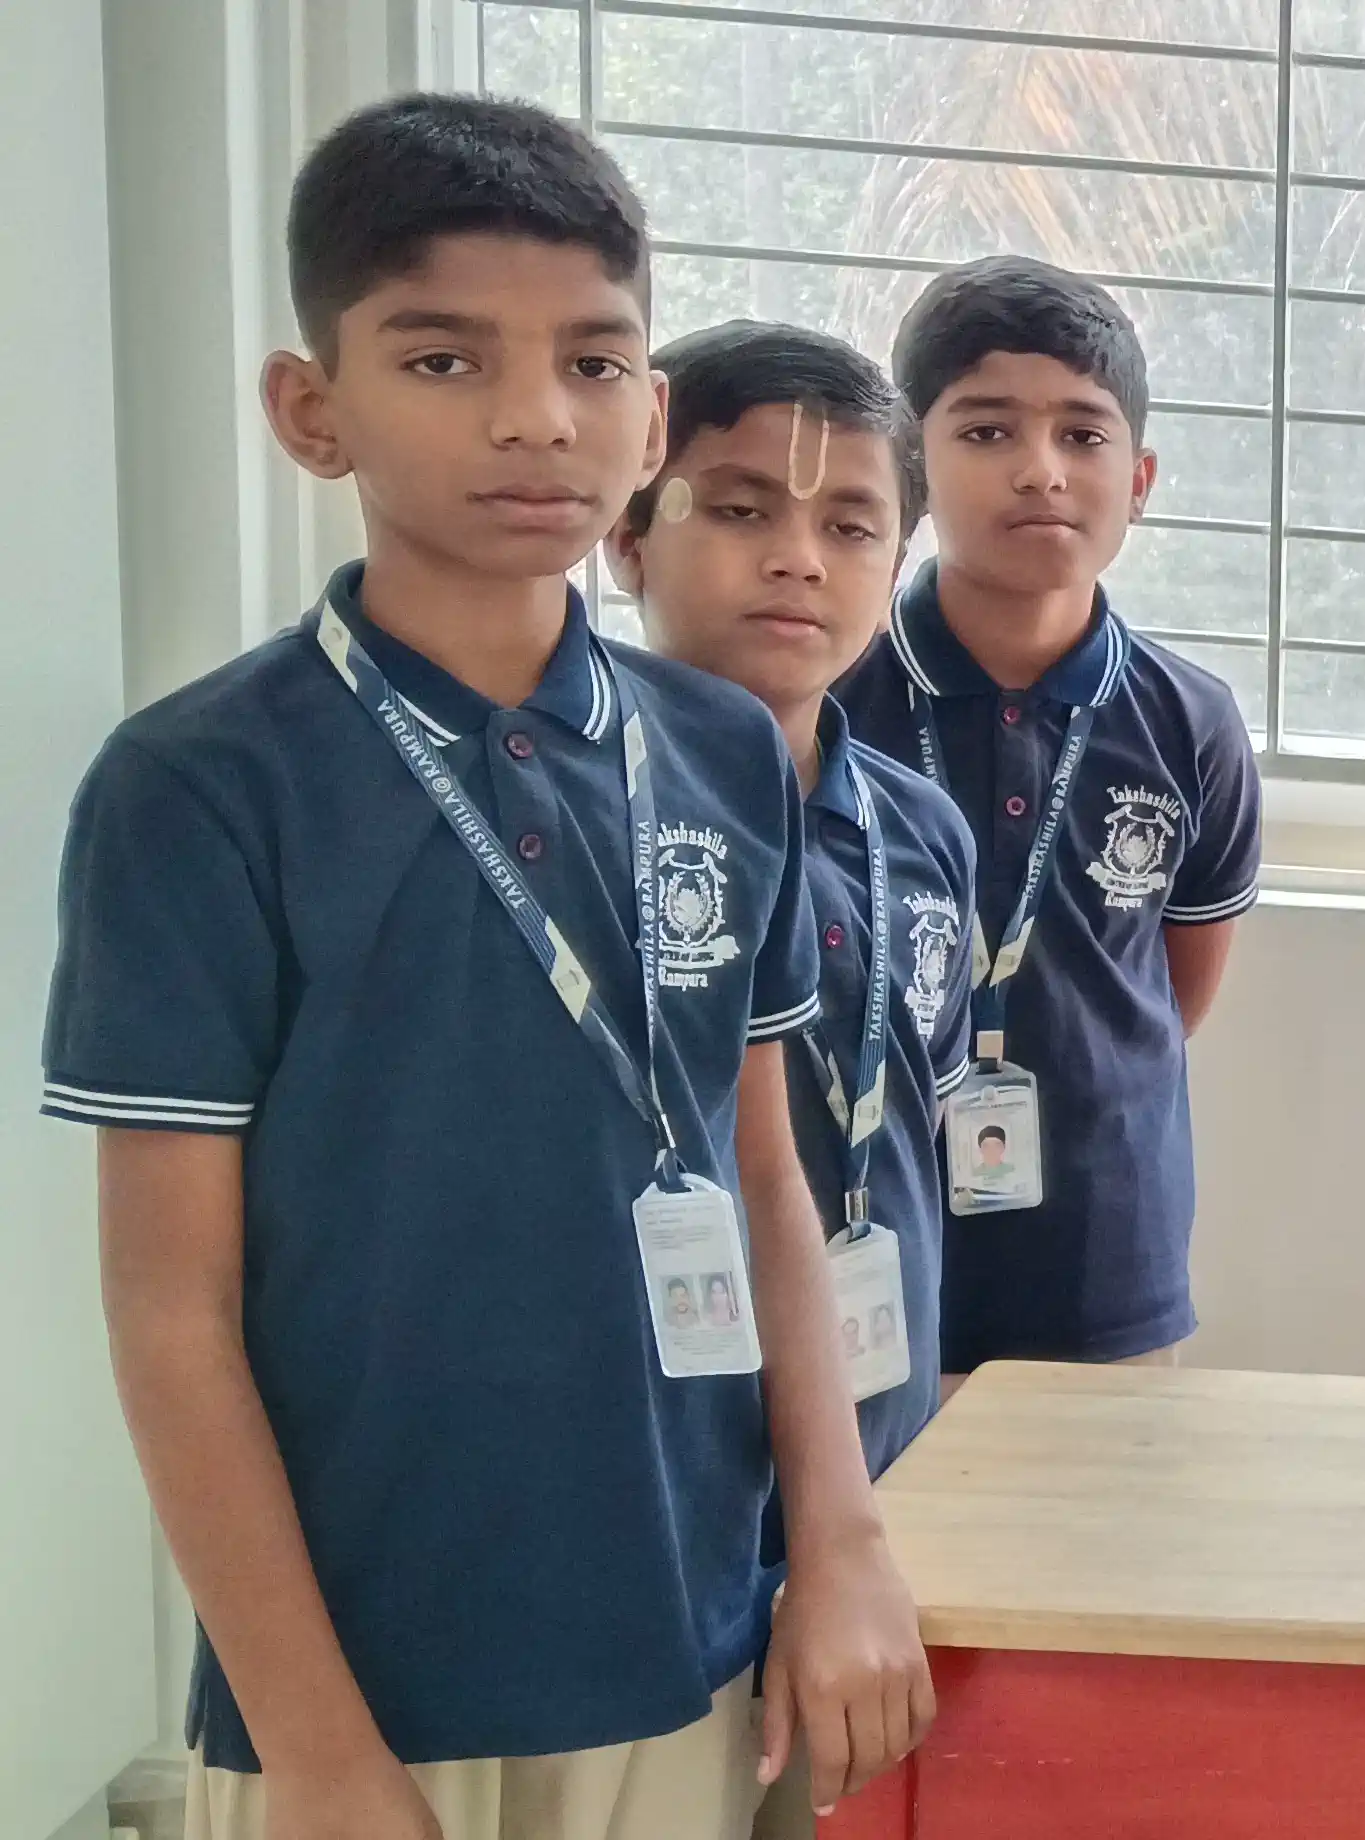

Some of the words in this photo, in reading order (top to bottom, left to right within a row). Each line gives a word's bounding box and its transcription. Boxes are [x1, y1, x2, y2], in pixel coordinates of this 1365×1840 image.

[376, 698, 527, 909] TAKSHASHILA@RAMPURA
[1106, 784, 1181, 820] Takshashila
[656, 820, 728, 860] akshashila
[867, 847, 886, 1041] TAKSHASHILA@RAMPURA
[657, 965, 709, 992] Rampura
